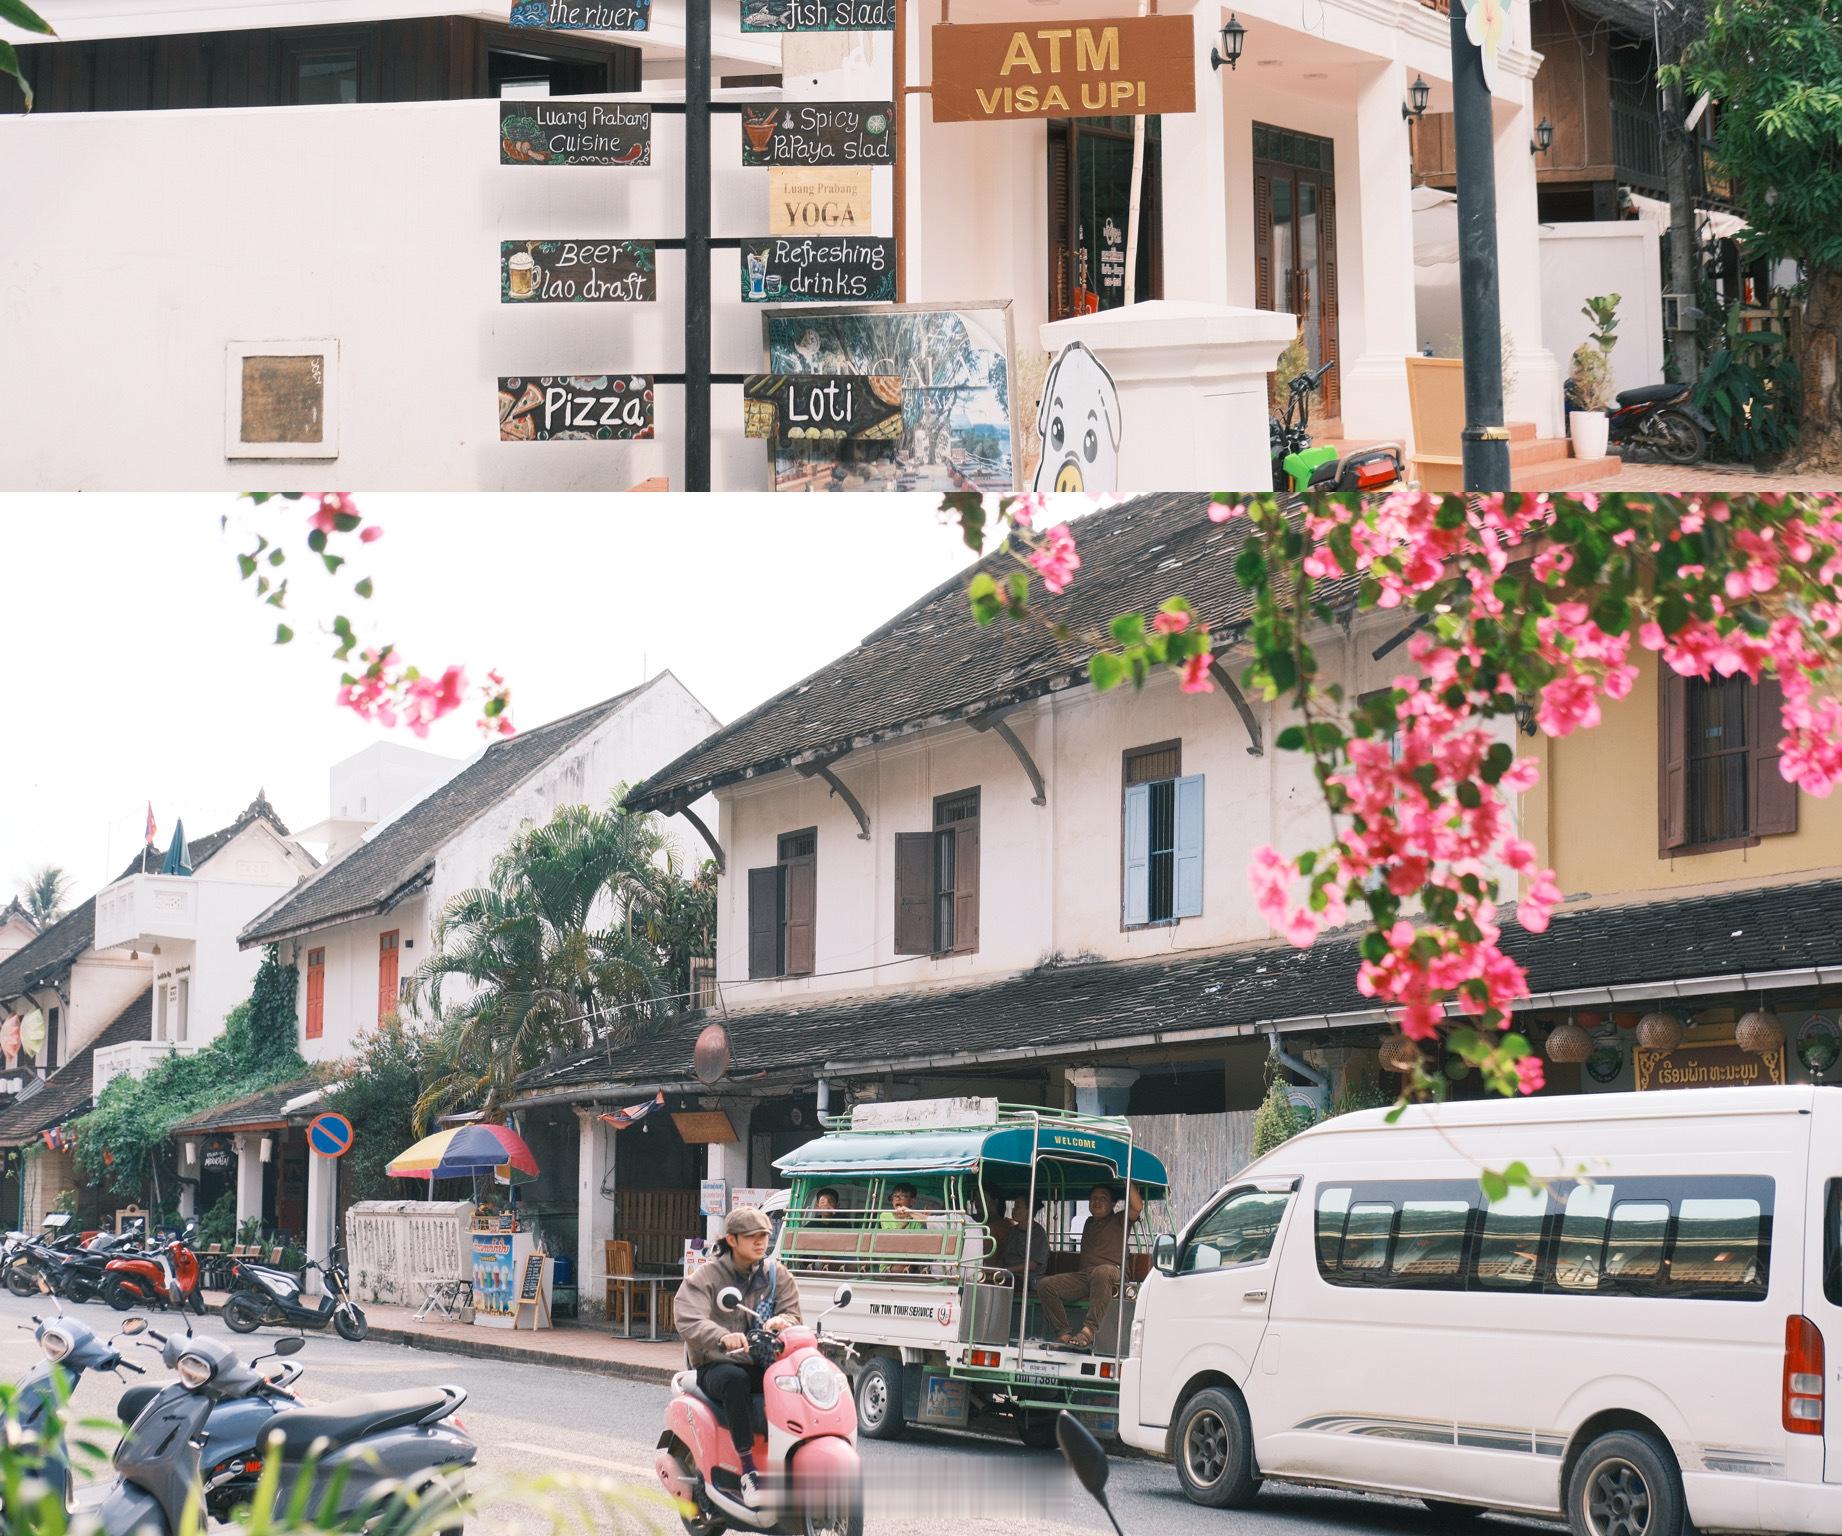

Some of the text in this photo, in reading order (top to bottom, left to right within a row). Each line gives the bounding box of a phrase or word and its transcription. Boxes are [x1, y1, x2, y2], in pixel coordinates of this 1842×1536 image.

[586, 4, 638, 27] river
[1000, 26, 1120, 75] ATM
[976, 80, 1146, 114] VISA UPI
[537, 105, 649, 131] Luang Prabang
[801, 107, 859, 137] Spicy
[550, 134, 621, 153] Cuisine
[844, 130, 889, 159] slad
[784, 183, 858, 197] Luang Prabang
[784, 201, 858, 228] YOGA
[555, 243, 624, 267] Beer
[774, 239, 885, 271] Refreshing
[541, 267, 647, 301] lao draft
[789, 267, 867, 296] drinks
[545, 387, 645, 430] Pizza
[788, 379, 852, 422] Loti
[1054, 1135, 1096, 1149] WELCOME
[869, 1304, 880, 1314] TUK
[881, 1304, 893, 1315] TUK
[909, 1306, 934, 1318] SERVICE
